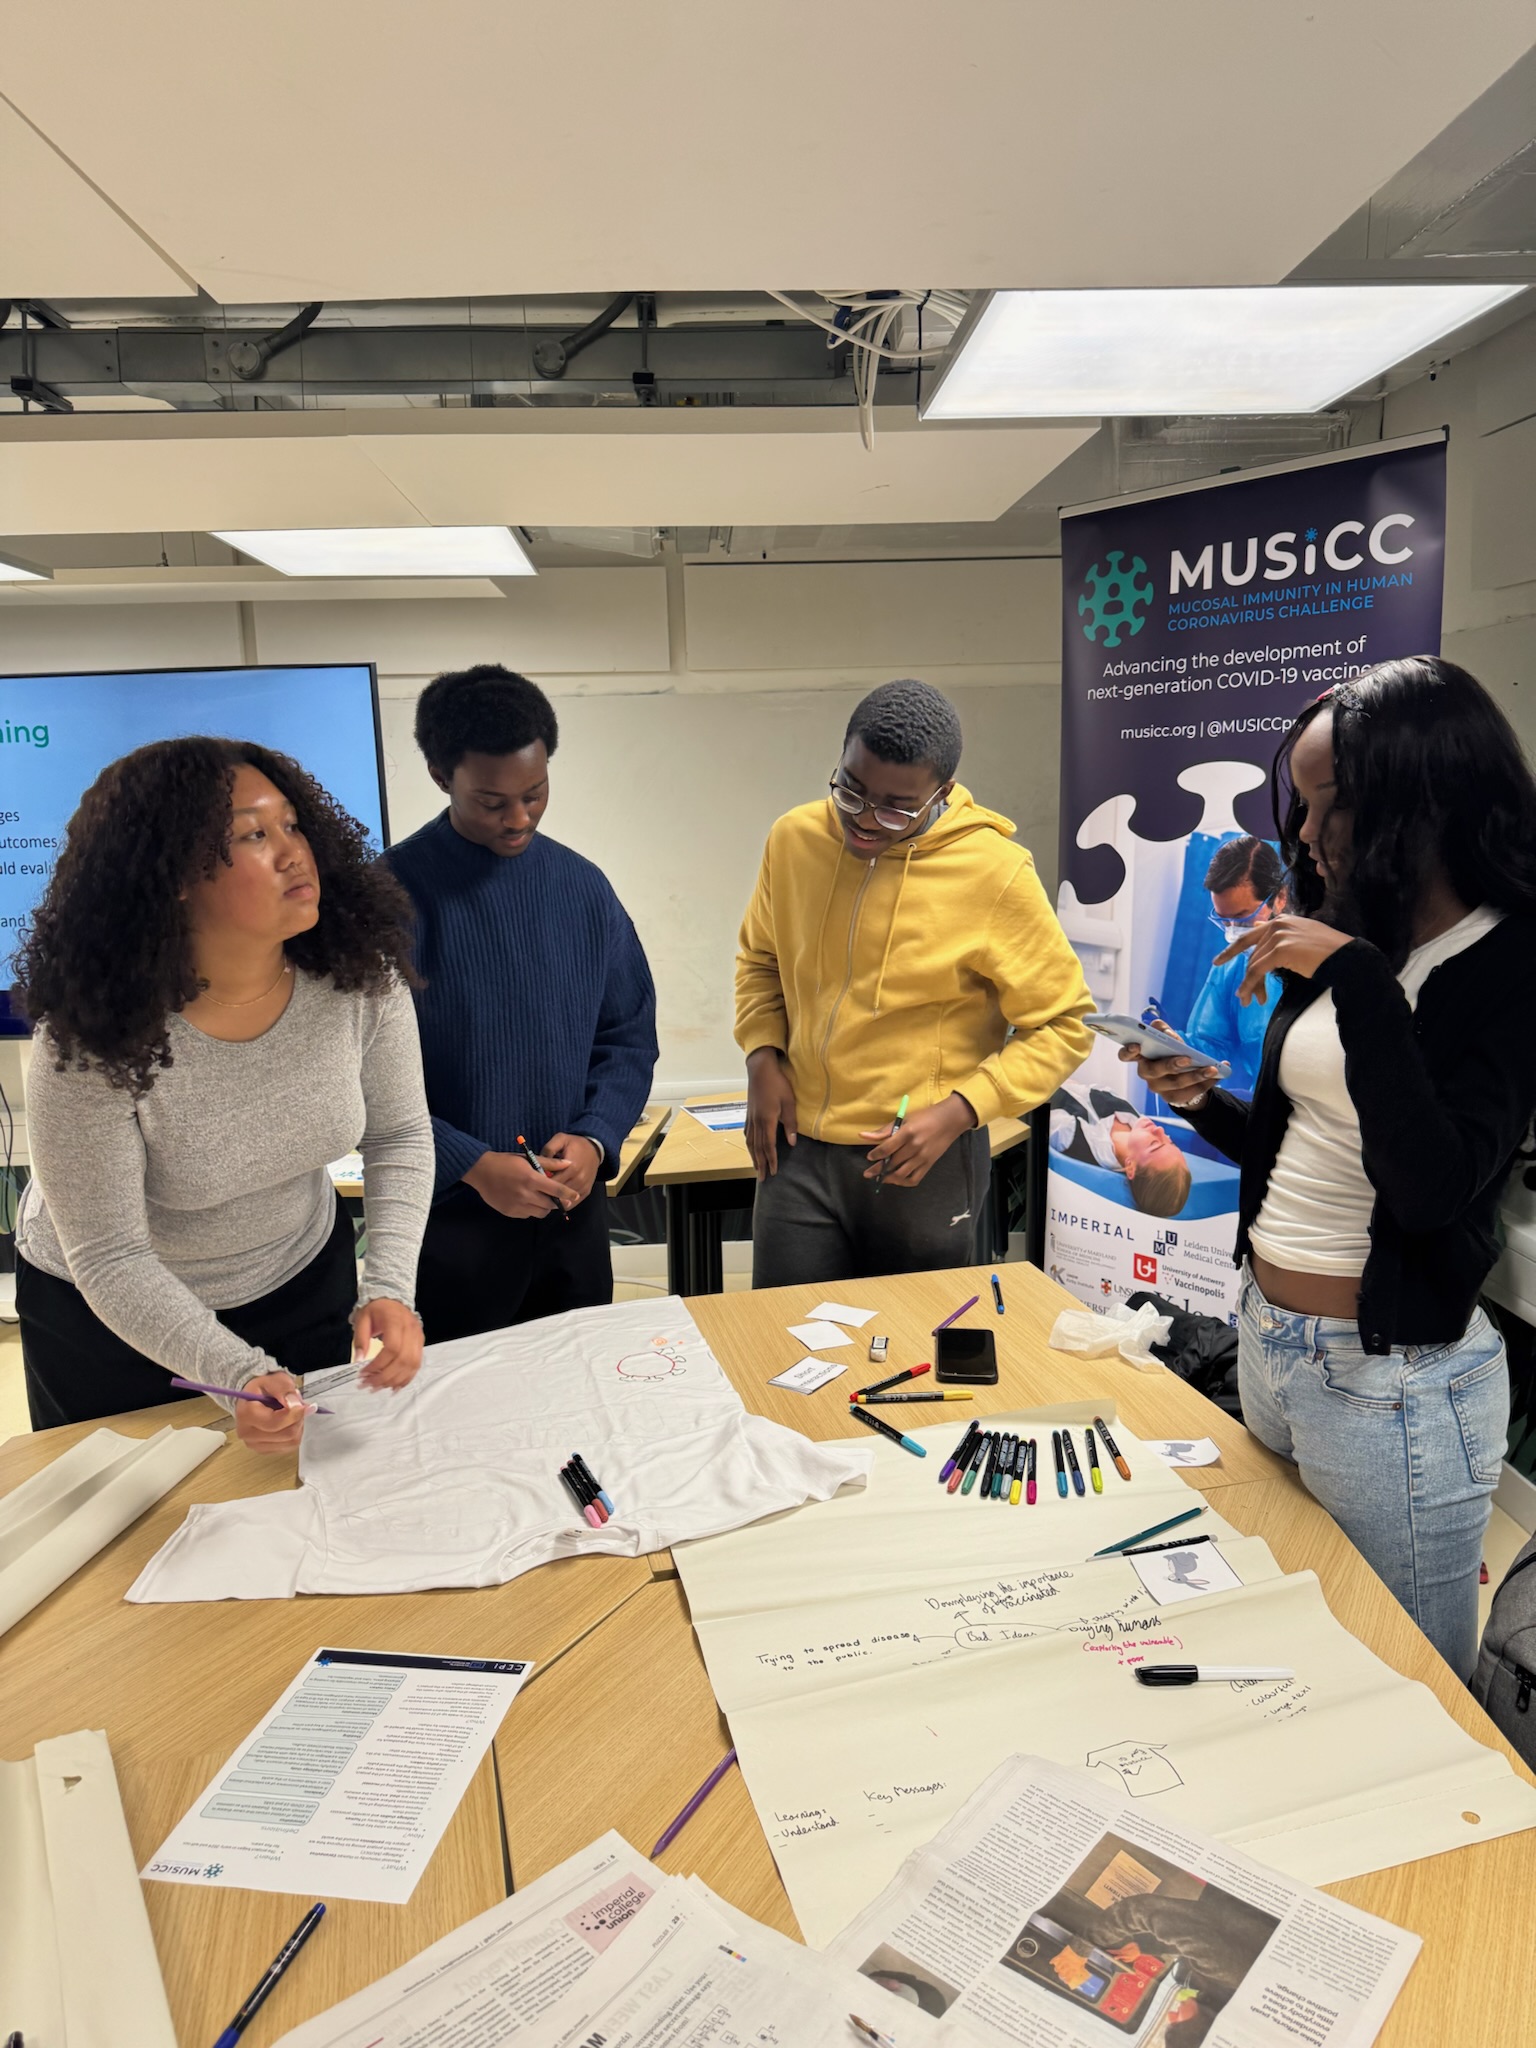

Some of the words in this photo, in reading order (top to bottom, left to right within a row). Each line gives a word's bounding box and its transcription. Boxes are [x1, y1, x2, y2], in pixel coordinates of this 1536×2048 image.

[1169, 596, 1238, 615] MUCOSAL
[1243, 584, 1322, 606] IMMUNITY
[1326, 581, 1342, 597] IN
[1347, 572, 1412, 592] HUMAN
[1168, 608, 1274, 632] CORONAVIRUS
[1278, 595, 1374, 618] CHALLENGE
[1103, 656, 1187, 678] Advancing
[1192, 652, 1219, 669] the
[1223, 639, 1342, 665] development
[1346, 636, 1367, 653] of
[1088, 676, 1212, 700] next-generation
[1217, 667, 1298, 689] COVID-19
[1120, 723, 1196, 740] musicc.org
[1, 914, 26, 927] and
[1051, 1208, 1134, 1241] IMPERIAL
[1184, 1240, 1209, 1252] Leiden
[1184, 1250, 1213, 1264] Medical
[1162, 1264, 1190, 1278] University
[1200, 1275, 1225, 1287] Antwerp
[1174, 1278, 1225, 1299] Vaccinopolis
[925, 1590, 1000, 1610] Downplaying
[998, 1582, 1016, 1594] the
[1017, 1570, 1073, 1589] importance
[982, 1599, 996, 1614] of
[1114, 1616, 1162, 1632] humans
[966, 1631, 992, 1642] Bad
[999, 1630, 1037, 1641] Ideas
[1123, 1641, 1136, 1649] the
[756, 1653, 794, 1666] Trying
[823, 1639, 860, 1653] spread
[872, 1632, 910, 1643] disease
[808, 1658, 824, 1666] the
[836, 1650, 873, 1662] public.
[492, 1662, 524, 1670] CEPI
[863, 1791, 893, 1804] Key
[894, 1783, 946, 1797] Messages:
[258, 1825, 300, 1833] Definitions
[781, 1816, 840, 1838] Understand
[380, 1863, 407, 1871] What?
[591, 1886, 636, 1920] imperial
[608, 1890, 646, 1920] college
[606, 1908, 635, 1930] union
[672, 1916, 680, 1924] 29
[1263, 1986, 1295, 2005] achieve
[1273, 1981, 1307, 2002] change.
[633, 2009, 672, 2048] orresponding
[684, 1982, 697, 1996] Use
[694, 1971, 708, 1986] your
[1249, 2005, 1270, 2018] push
[1261, 2003, 1279, 2015] and
[1266, 1997, 1287, 2011] does
[1294, 2002, 1304, 2010] to
[1304, 2007, 1315, 2016] bit
[1305, 1998, 1339, 2018] positive
[652, 2029, 664, 2041] the
[662, 2012, 681, 2031] secret
[678, 1990, 702, 2016] message
[1269, 2015, 1300, 2034] efforts,
[1287, 2006, 1331, 2032] everybody
[1315, 2013, 1334, 2025] little
[1277, 2011, 1327, 2040] boundaries,
[1298, 2032, 1322, 2047] Make
